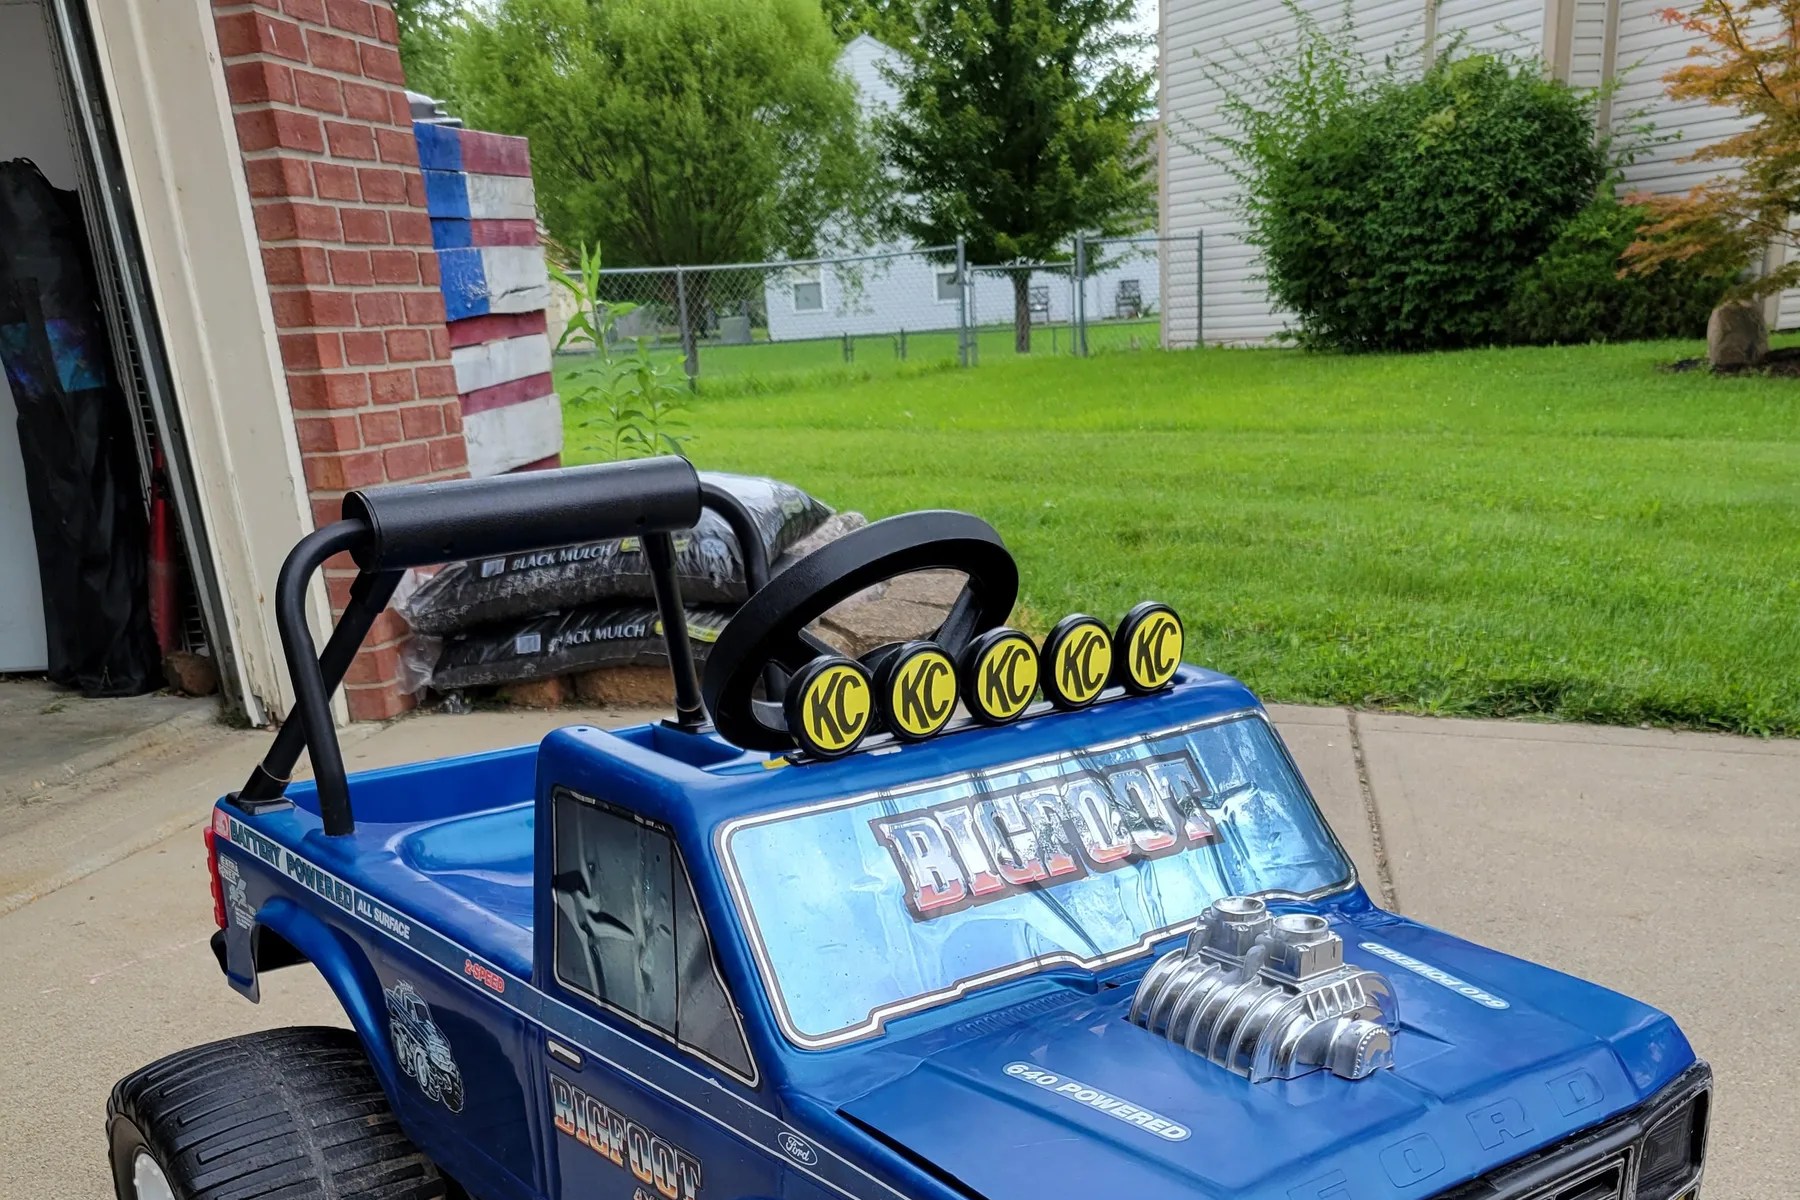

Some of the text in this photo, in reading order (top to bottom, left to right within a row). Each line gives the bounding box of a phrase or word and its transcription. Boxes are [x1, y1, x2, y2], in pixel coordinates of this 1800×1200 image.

[512, 555, 555, 571] BLACK
[560, 543, 613, 562] MULCH
[595, 624, 646, 640] MULCH
[1063, 631, 1106, 698] KC
[1136, 617, 1178, 684] KC
[811, 671, 864, 745] KC
[901, 659, 949, 730] KC
[986, 644, 1031, 713] KC
[229, 819, 282, 868] BATTERY
[286, 851, 351, 910] POWERED
[357, 898, 411, 941] ALL SURFACE
[464, 959, 505, 993] 2-SPEED
[1361, 942, 1507, 1008] 640 POWERED
[1006, 1064, 1187, 1139] 640 POWERED
